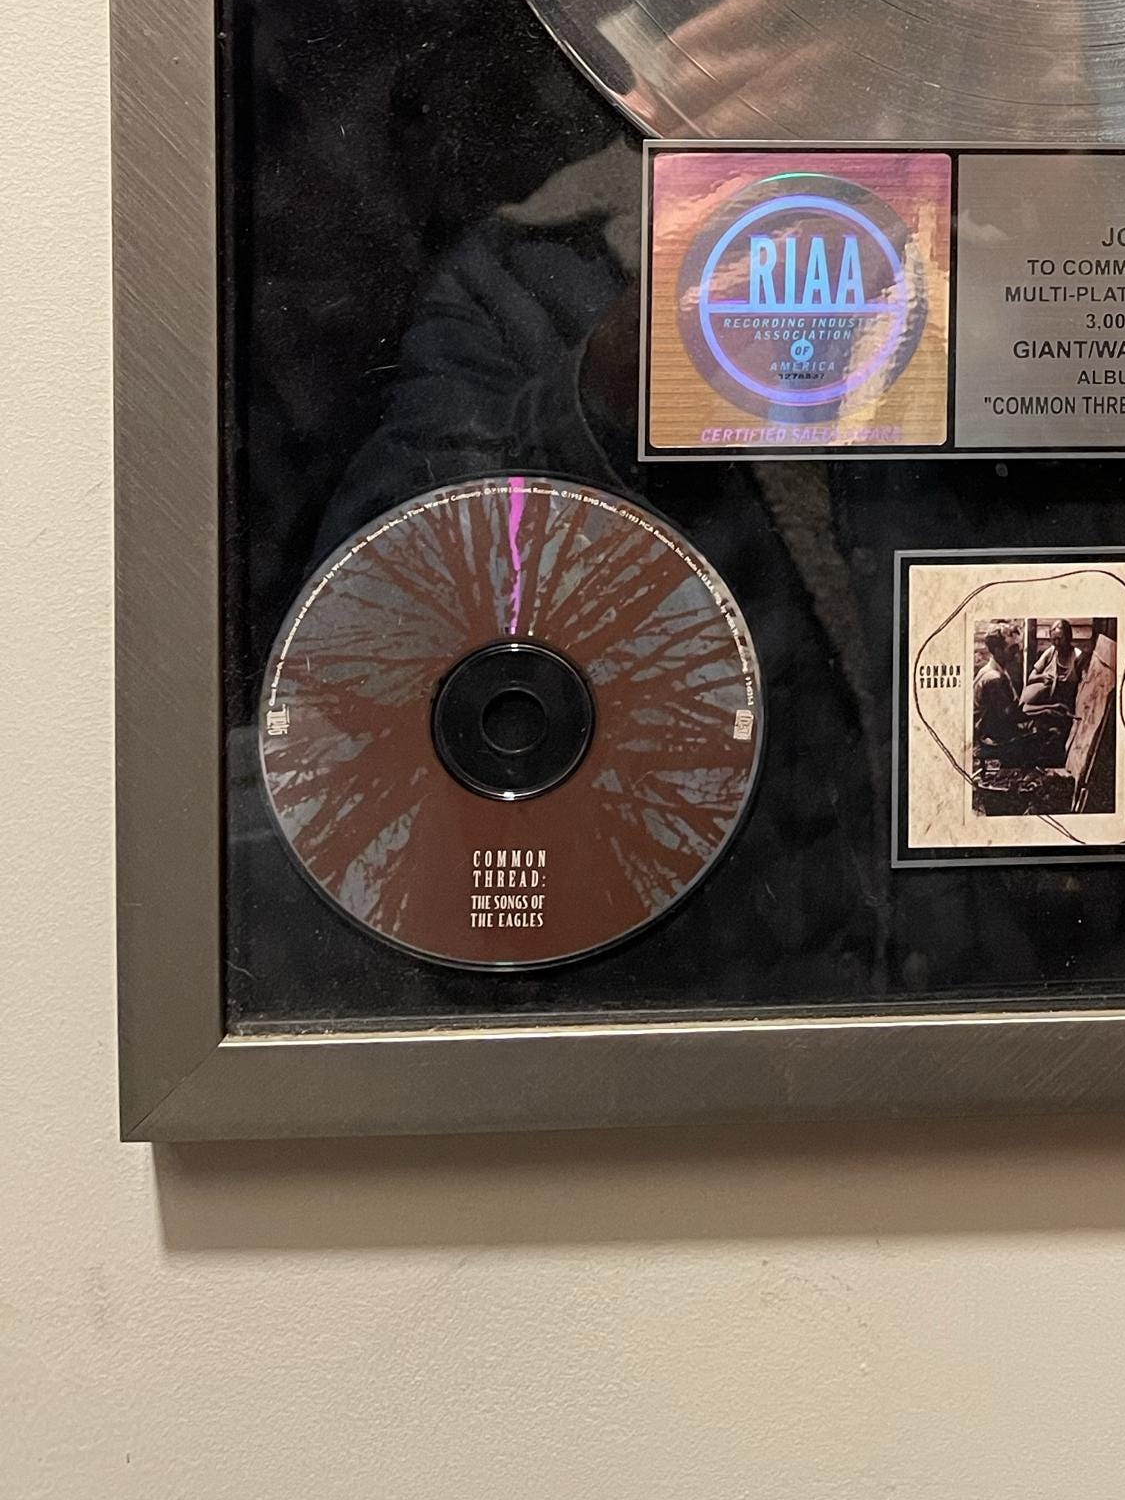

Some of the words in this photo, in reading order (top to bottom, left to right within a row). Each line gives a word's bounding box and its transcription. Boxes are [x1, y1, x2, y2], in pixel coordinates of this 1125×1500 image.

[750, 235, 865, 310] RIAA
[1027, 260, 1055, 276] TO
[724, 318, 805, 328] RECORDING
[754, 330, 851, 341] ASSOCIATION
[795, 347, 810, 356] OF
[770, 361, 835, 372] AMERICA
[984, 397, 1075, 414] "COMMON
[701, 428, 786, 442] CERTIFIED
[920, 665, 961, 677] COMMON
[920, 677, 961, 689] THREAD:
[473, 850, 546, 867] COMMON
[473, 870, 546, 887] THREAD:
[471, 895, 491, 909] THE
[494, 895, 528, 909] SONGS
[531, 895, 545, 909] OF
[470, 913, 493, 927] THE
[498, 913, 544, 927] EAGLES
